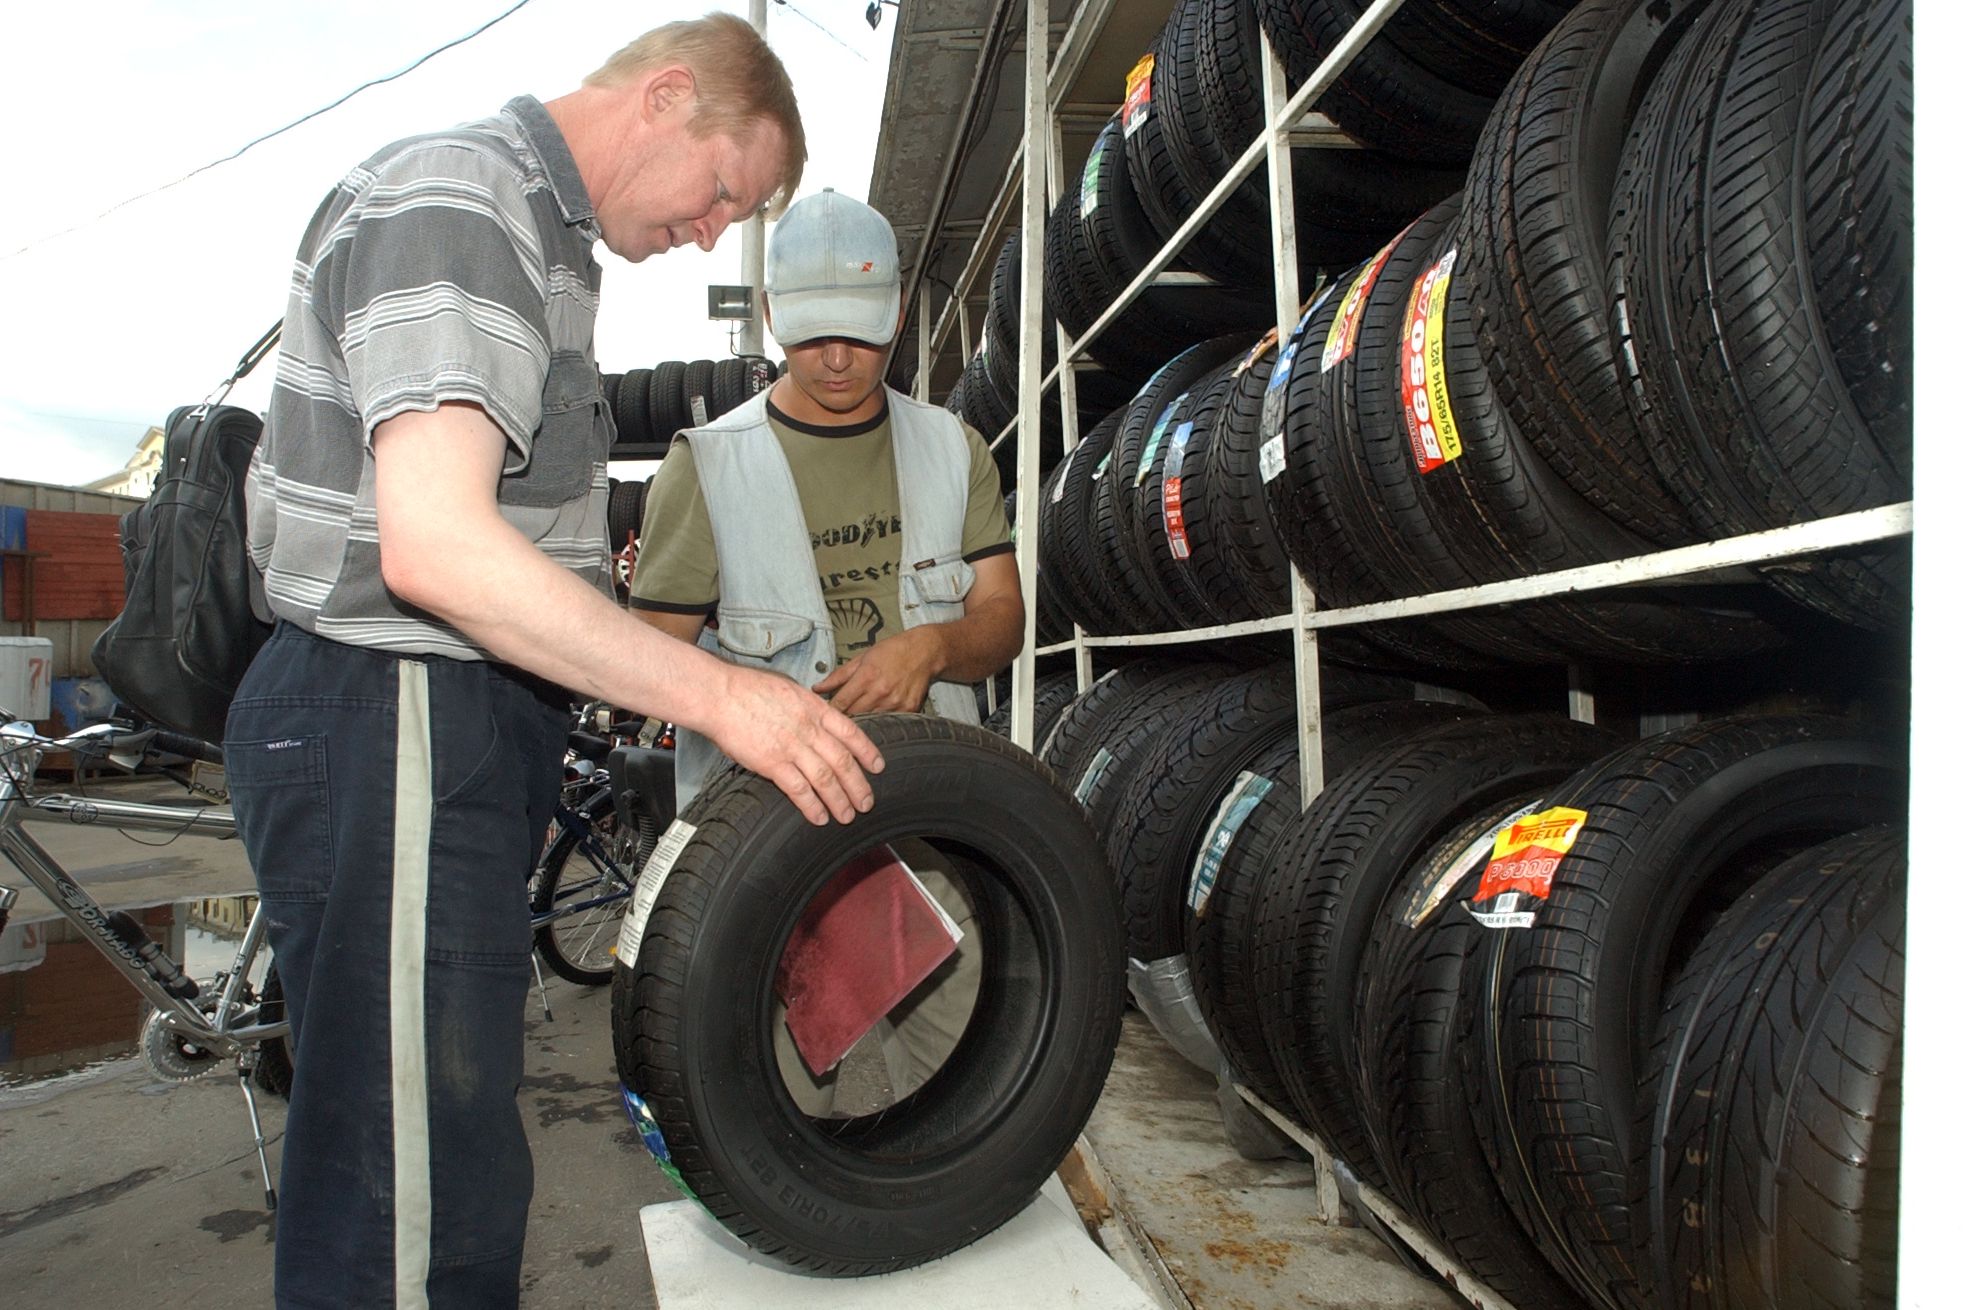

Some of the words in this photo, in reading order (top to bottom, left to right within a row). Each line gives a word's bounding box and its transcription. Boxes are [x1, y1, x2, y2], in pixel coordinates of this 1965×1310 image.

[1411, 319, 1442, 459] B650
[1430, 338, 1440, 367] 82T
[1433, 370, 1456, 452] 175/65R14
